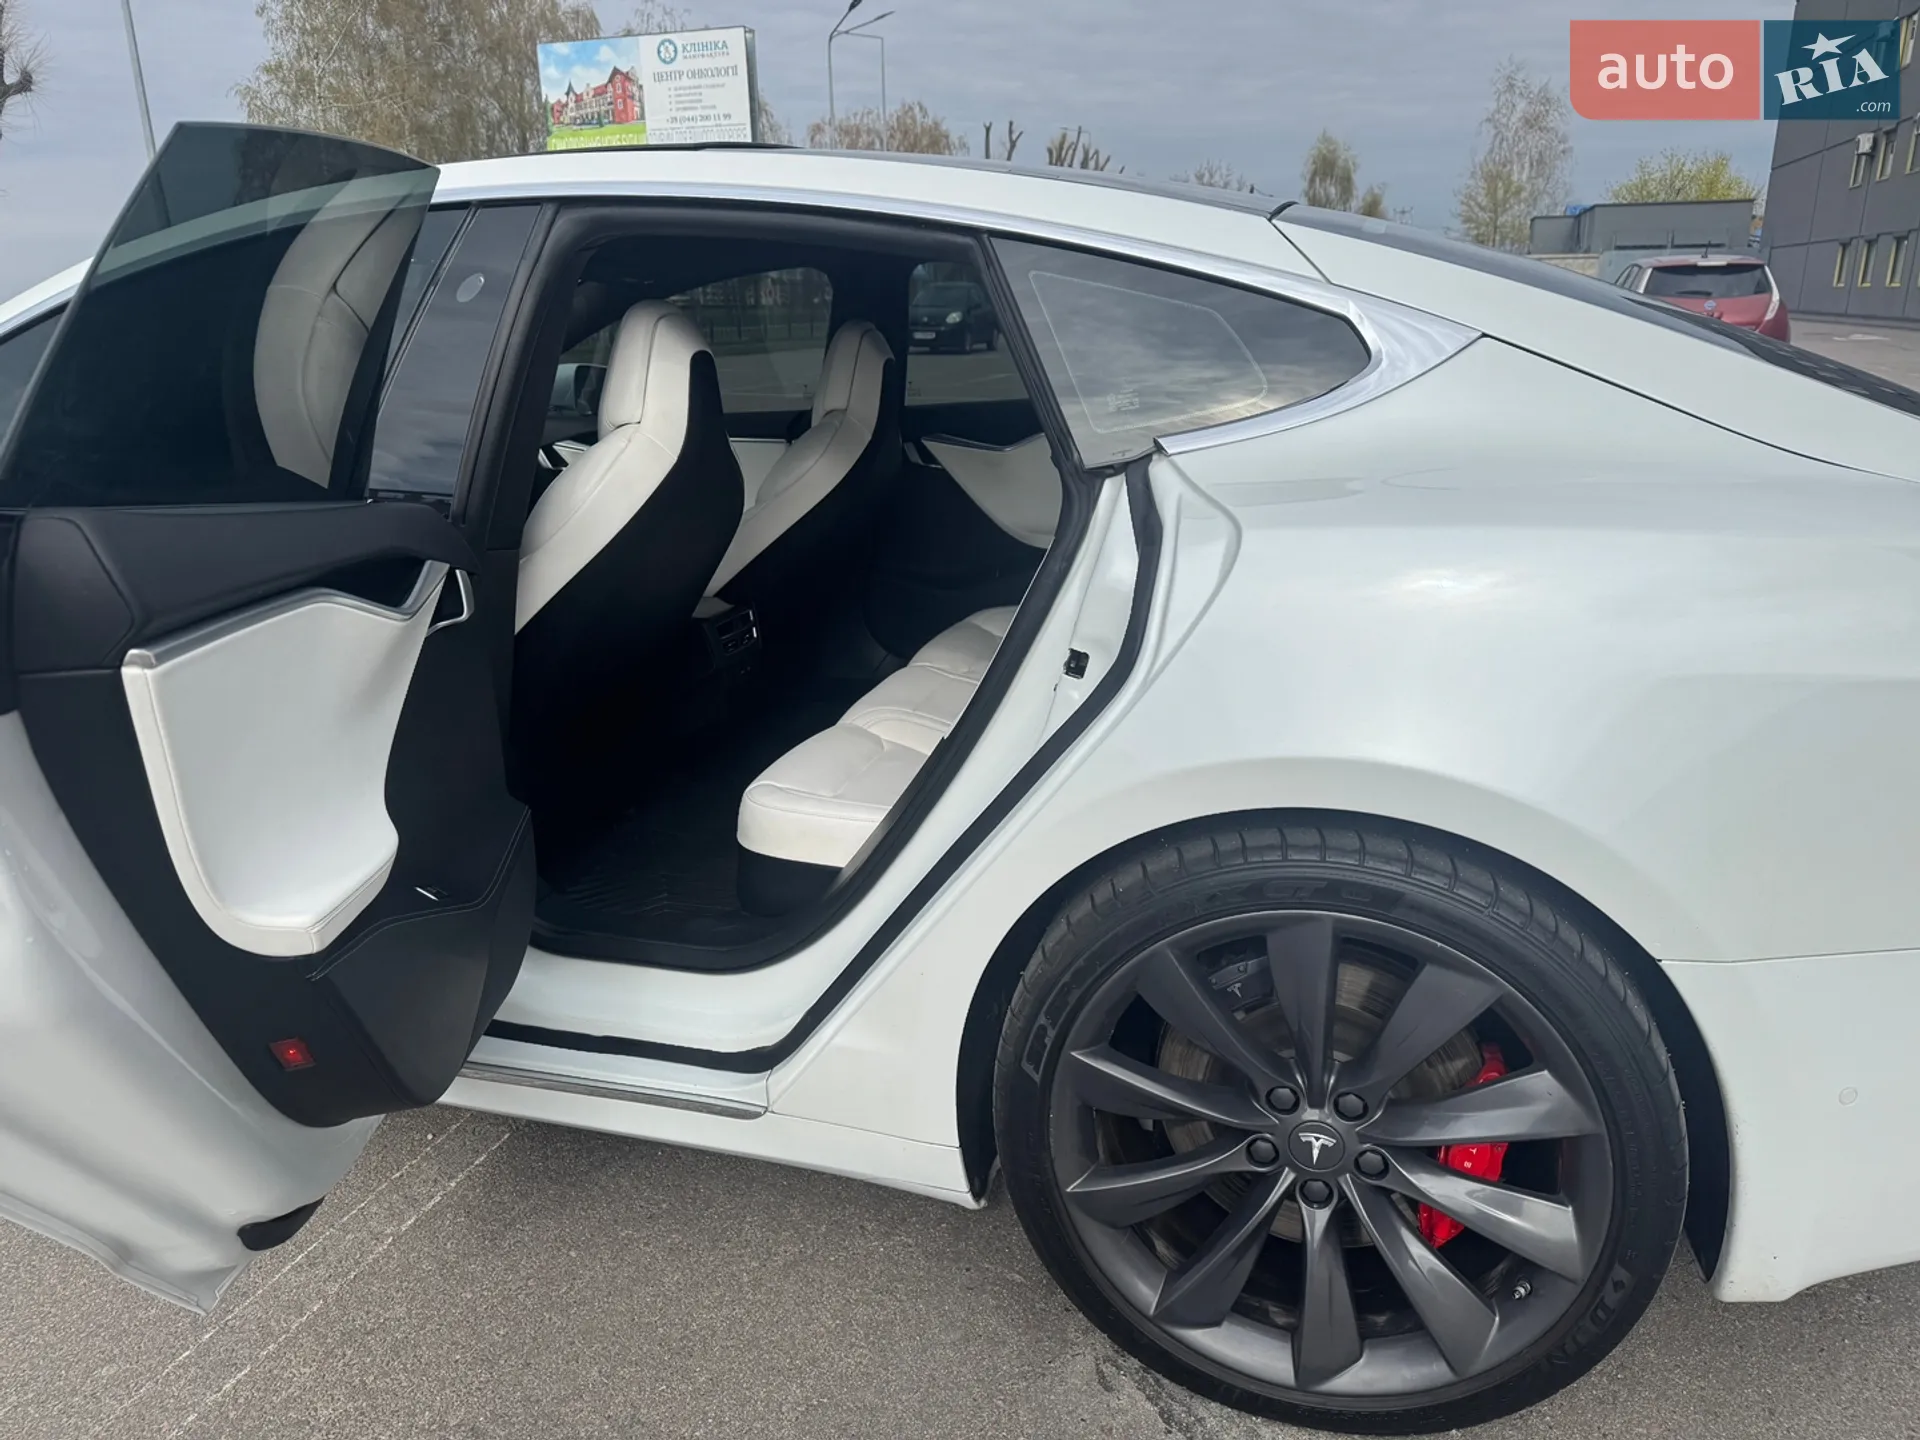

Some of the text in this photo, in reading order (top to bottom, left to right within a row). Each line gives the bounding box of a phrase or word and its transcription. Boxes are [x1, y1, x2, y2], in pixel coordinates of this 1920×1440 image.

[682, 40, 728, 53] КЛІНІКА
[653, 65, 738, 83] ЦЕНТР ОНКОЛОГІЇ
